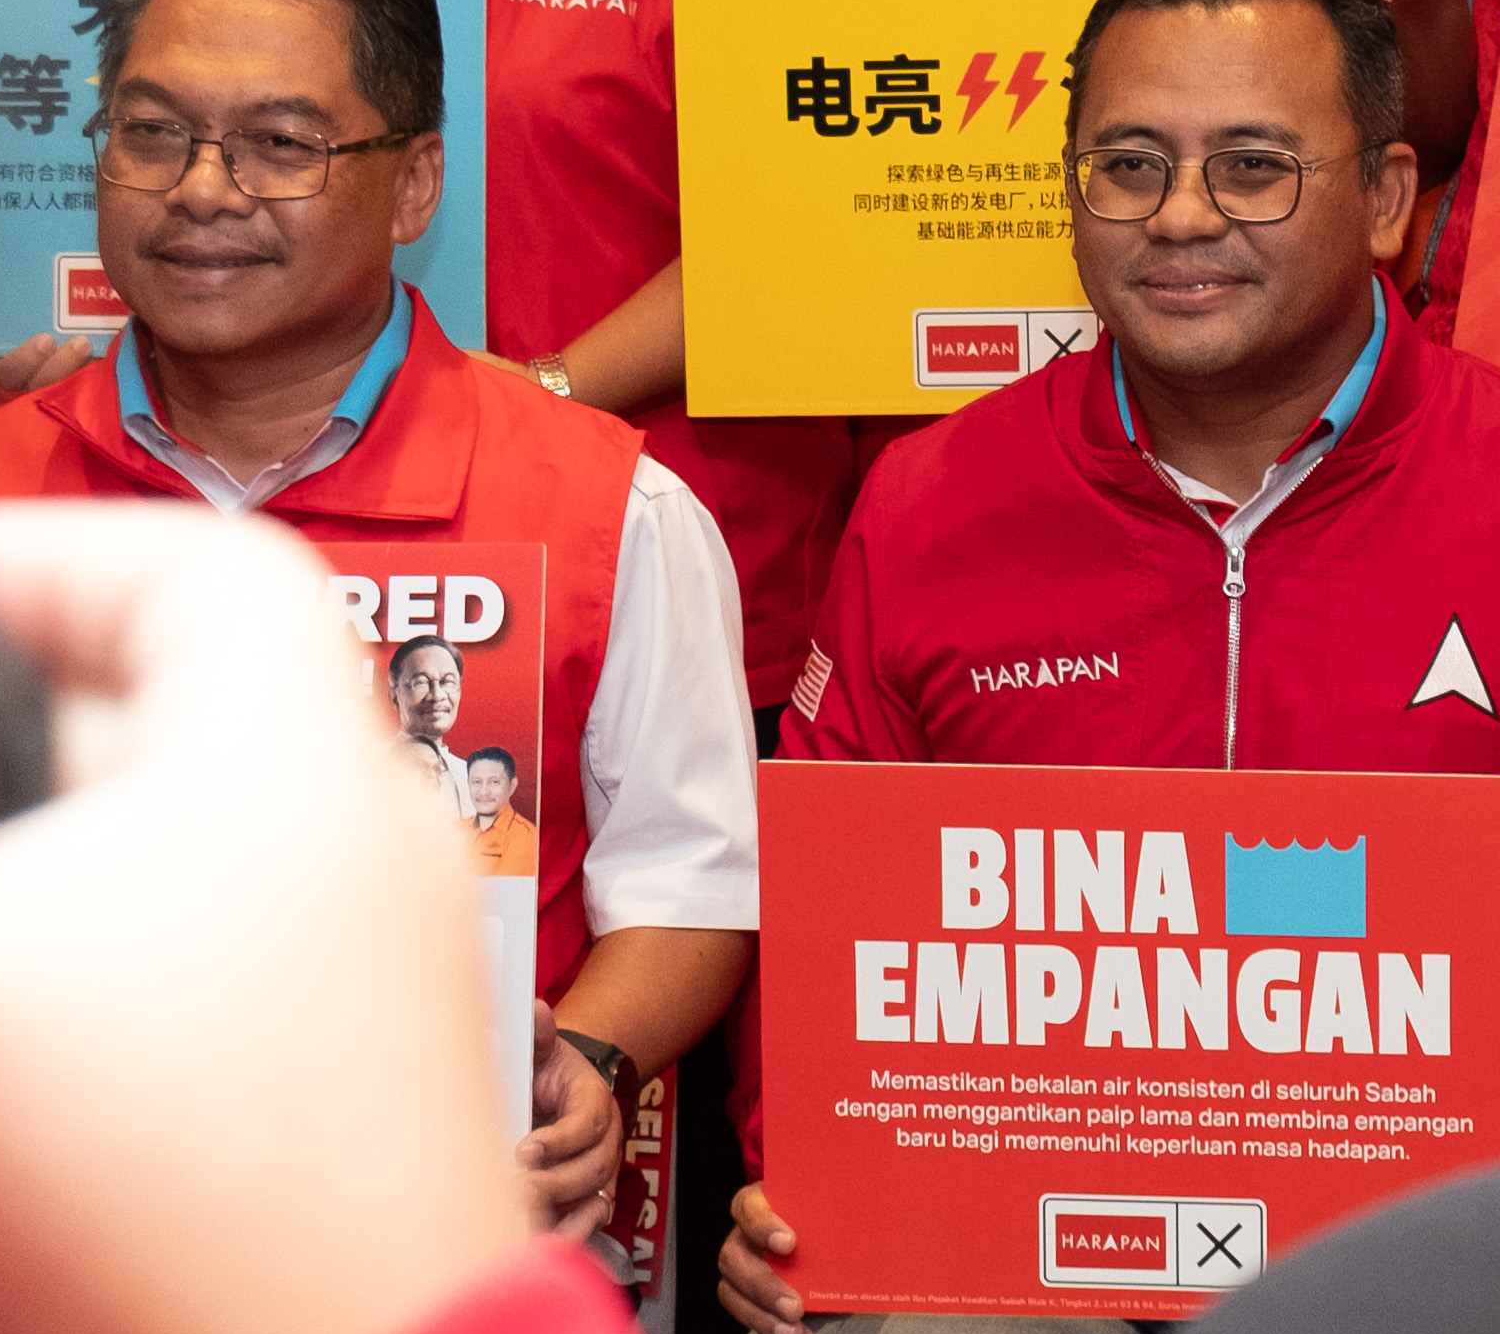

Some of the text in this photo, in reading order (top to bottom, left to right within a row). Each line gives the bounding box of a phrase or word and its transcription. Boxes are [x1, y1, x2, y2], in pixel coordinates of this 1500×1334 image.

[786, 55, 942, 138] 电亮
[887, 162, 1066, 183] 探索绿色与再生能源
[931, 341, 1015, 357] HARAPAN
[971, 653, 1119, 695] HARAPAN
[941, 827, 1199, 935] BINA
[855, 941, 1451, 1056] EMPANGAN
[871, 1070, 1436, 1104] Memastikan bekalan air konsisten di seluruh Sabah
[835, 1098, 1473, 1138] dengan menggantikan paip lama dan membina empangan
[897, 1127, 1410, 1163] baru bagi memenuhi keperluan masa hadapan.
[1061, 1233, 1160, 1253] HARAPAN
